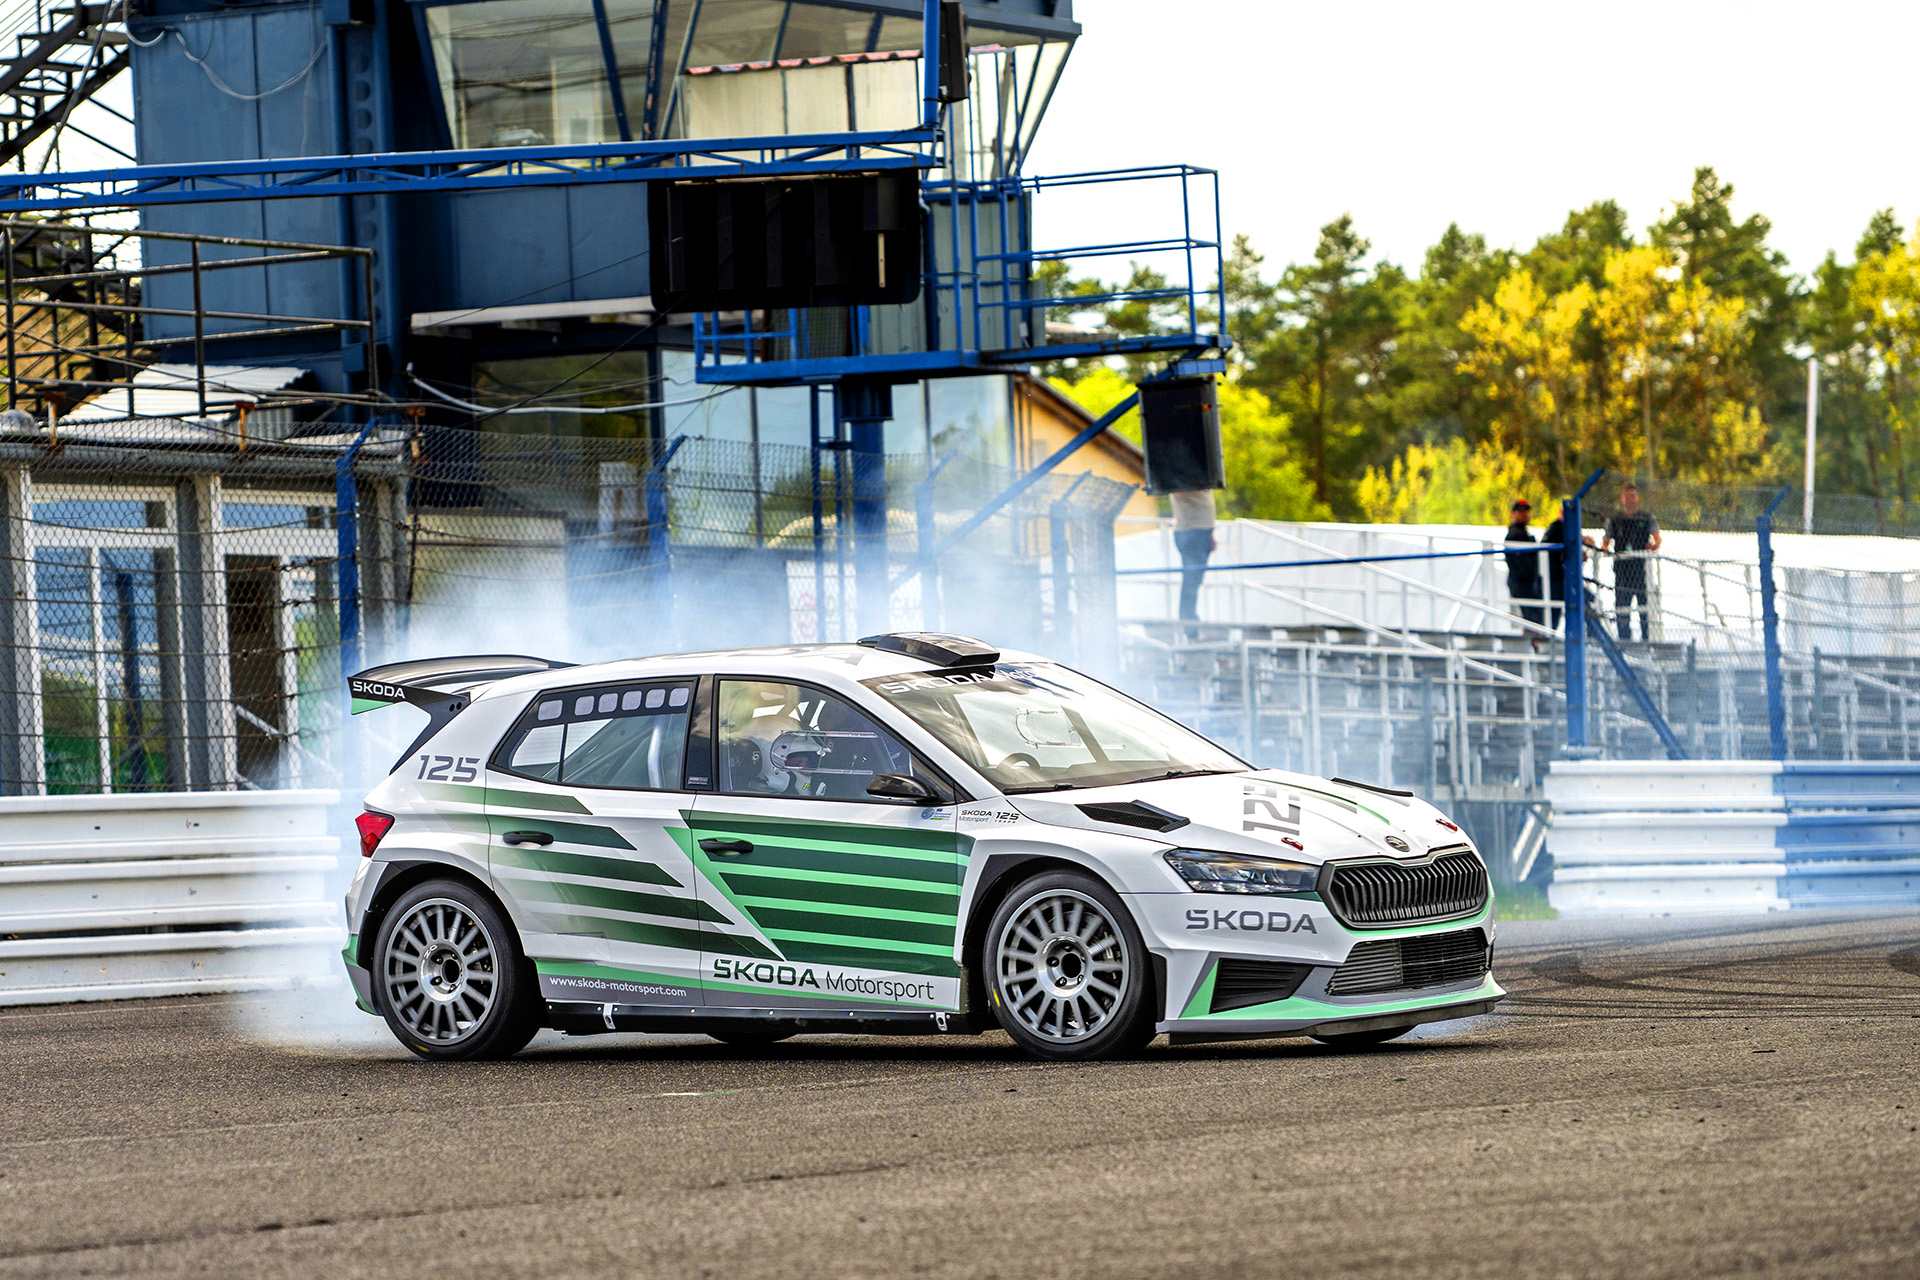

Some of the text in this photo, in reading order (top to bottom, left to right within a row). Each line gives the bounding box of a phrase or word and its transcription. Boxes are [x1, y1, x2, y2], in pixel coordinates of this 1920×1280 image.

[417, 755, 481, 782] 125
[995, 811, 1020, 821] 125
[549, 976, 687, 997] www.skoda-motorsport.com
[825, 970, 935, 1001] Motorsport
